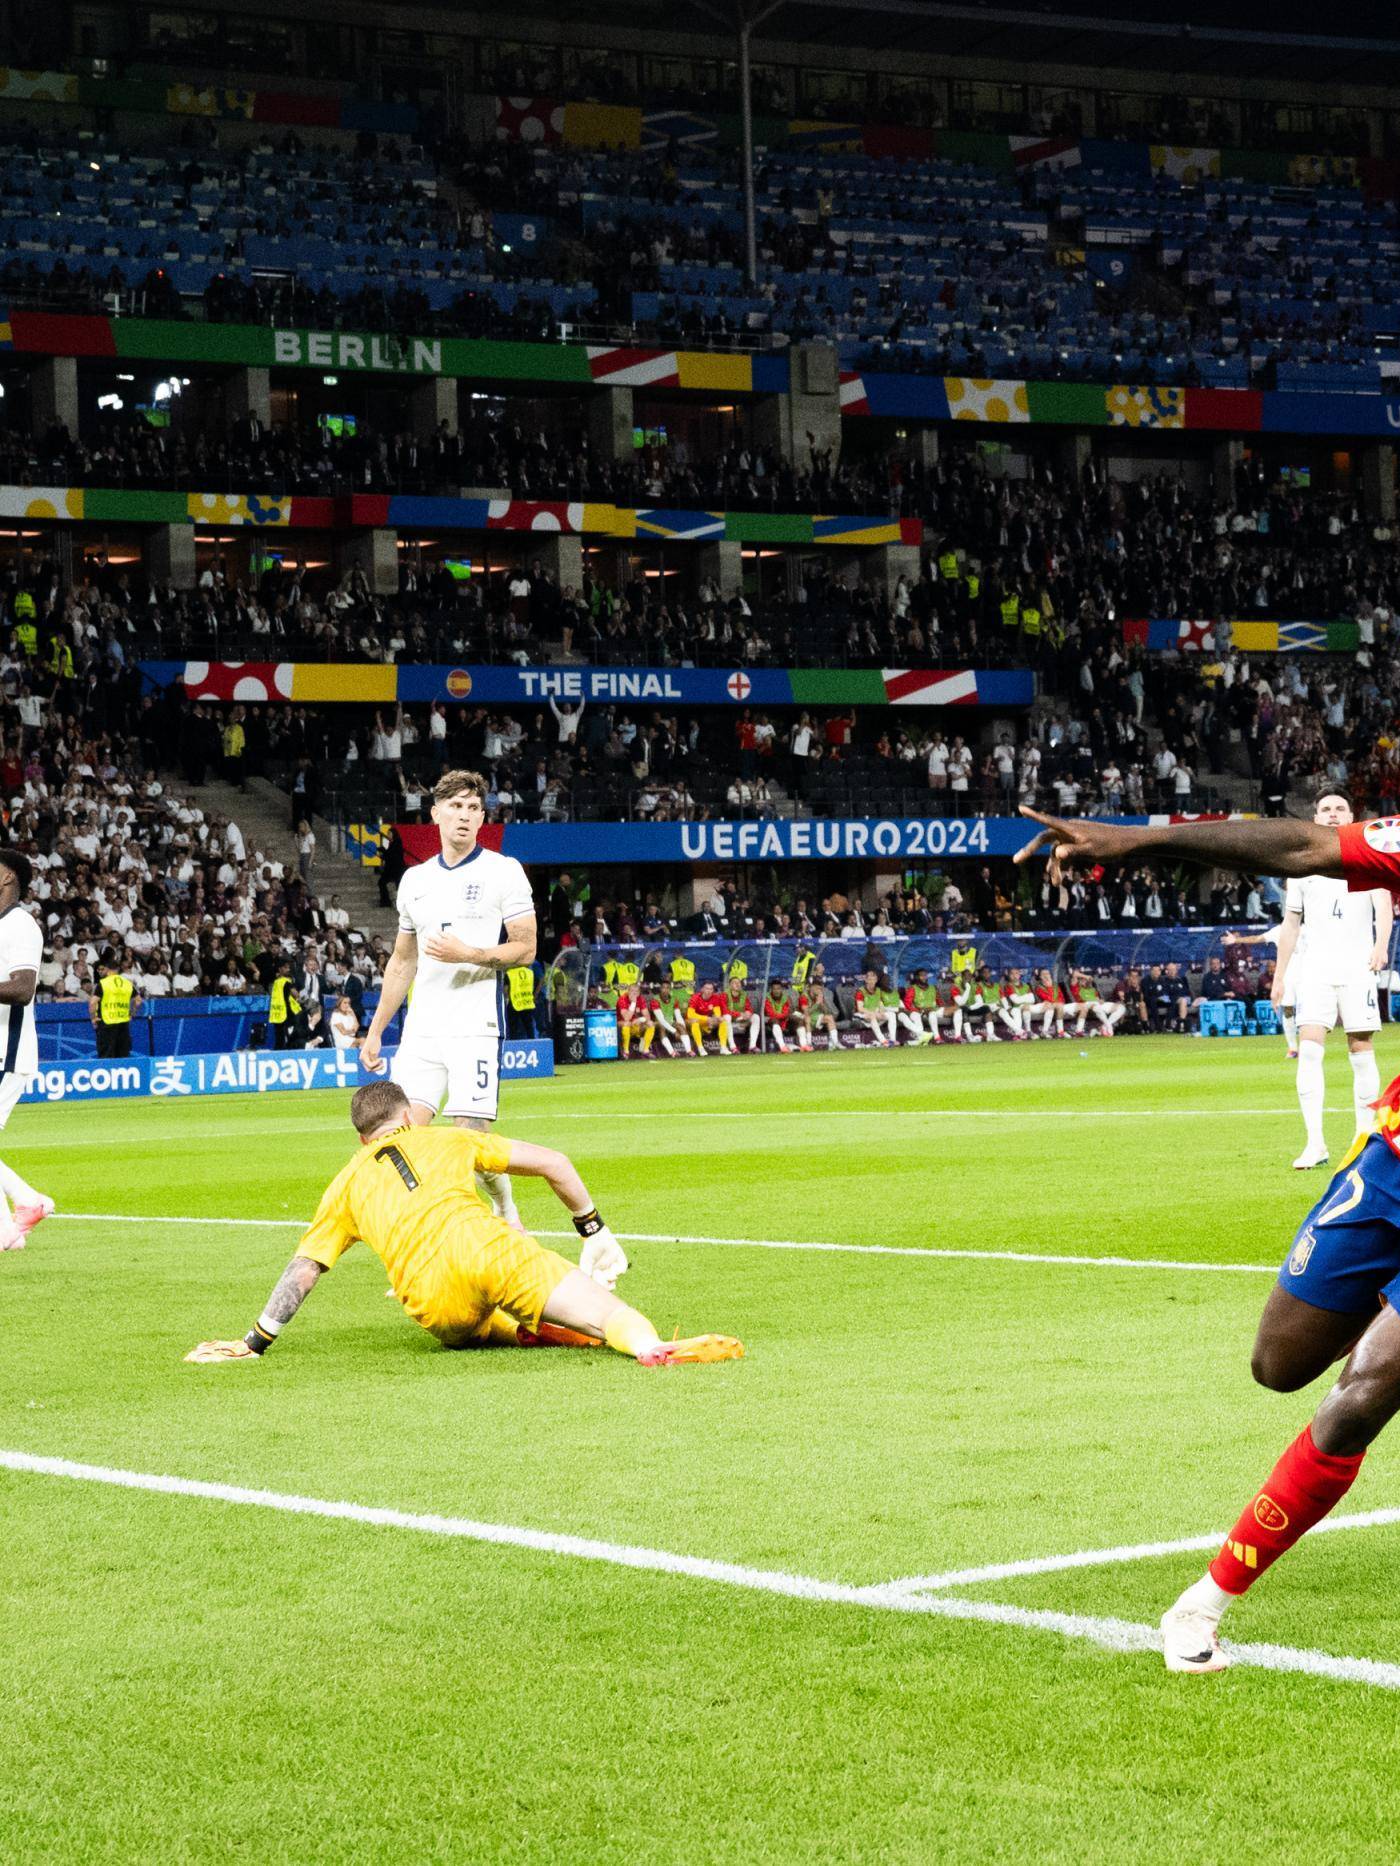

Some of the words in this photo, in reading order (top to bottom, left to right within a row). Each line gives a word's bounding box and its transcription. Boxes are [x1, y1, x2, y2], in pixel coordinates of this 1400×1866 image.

[521, 223, 537, 241] 8
[519, 672, 582, 697] THE
[591, 673, 682, 698] FINAL
[1332, 899, 1343, 919] 4
[1367, 989, 1376, 1009] 4
[211, 1054, 318, 1091] Alipay
[502, 1050, 539, 1069] 024
[20, 1067, 140, 1100] ng.com
[476, 1059, 488, 1089] 5
[374, 1144, 420, 1192] 1
